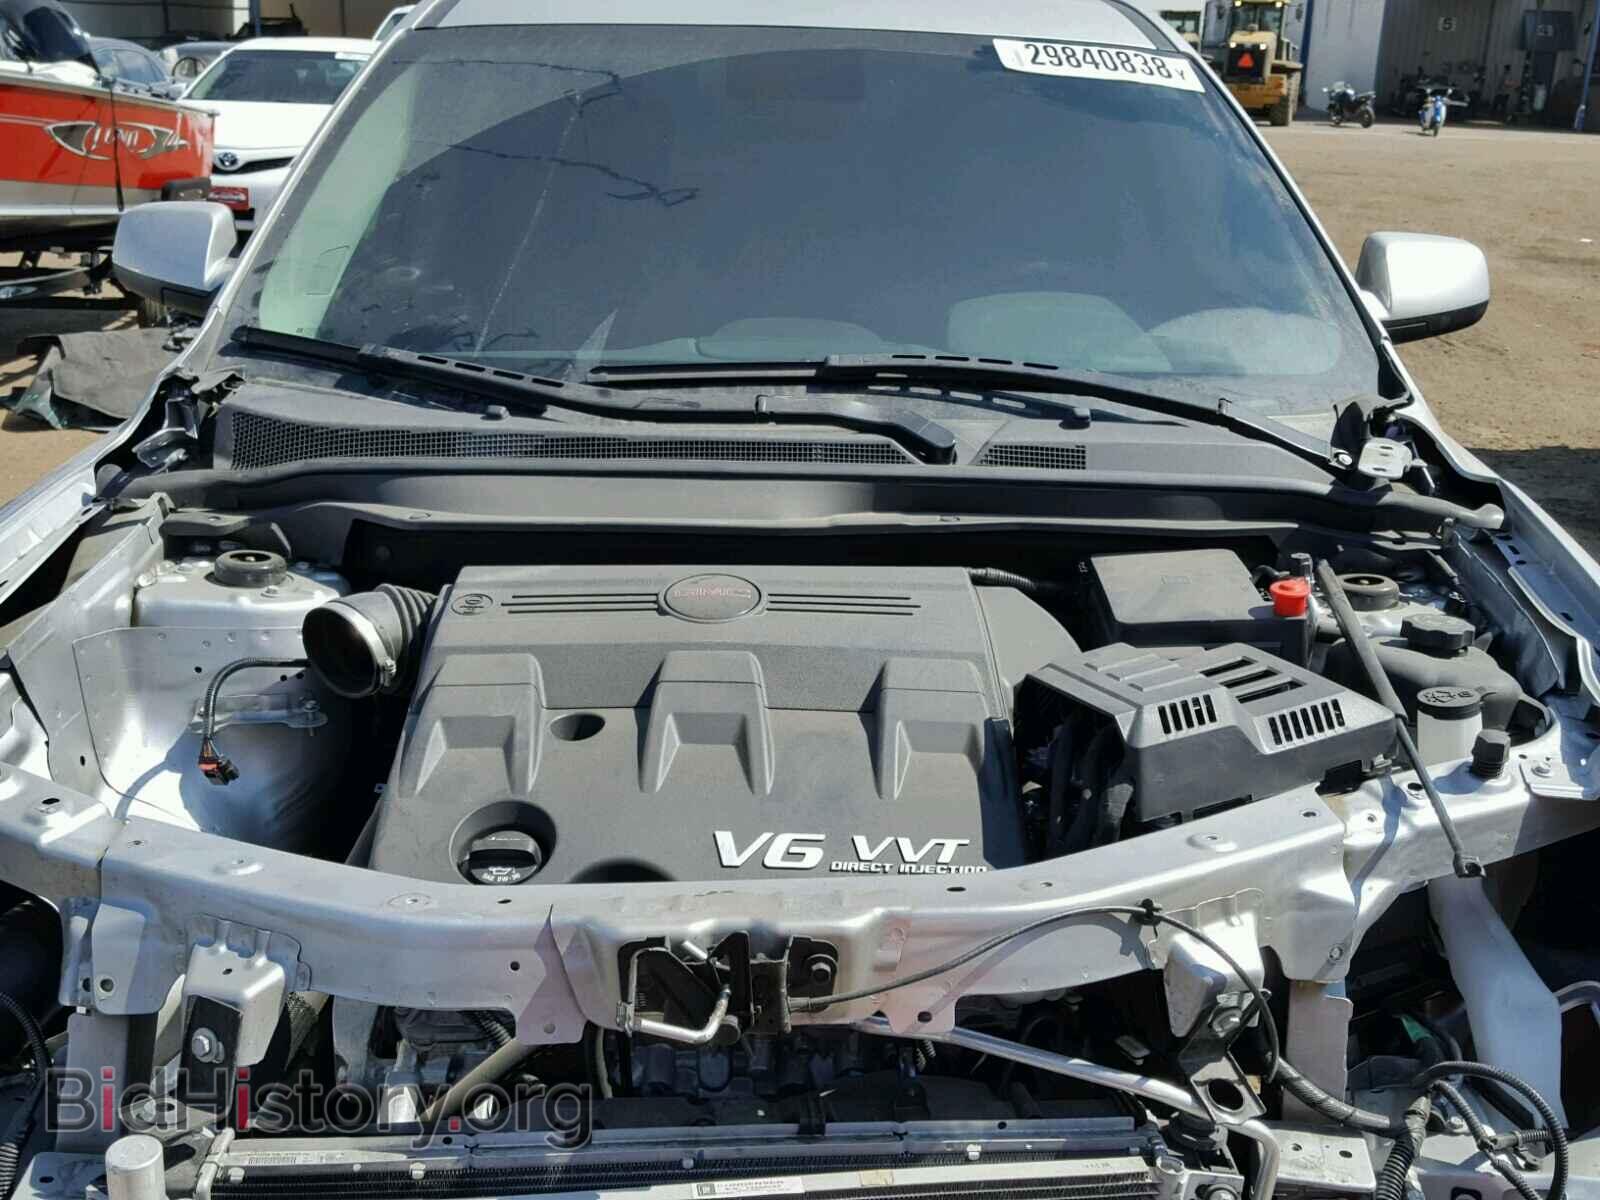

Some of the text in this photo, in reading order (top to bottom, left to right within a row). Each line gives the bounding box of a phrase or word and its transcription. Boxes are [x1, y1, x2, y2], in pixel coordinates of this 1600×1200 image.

[1024, 43, 1172, 79] 29840838
[714, 830, 970, 869] V6 VVT
[830, 861, 895, 873] DIRECT
